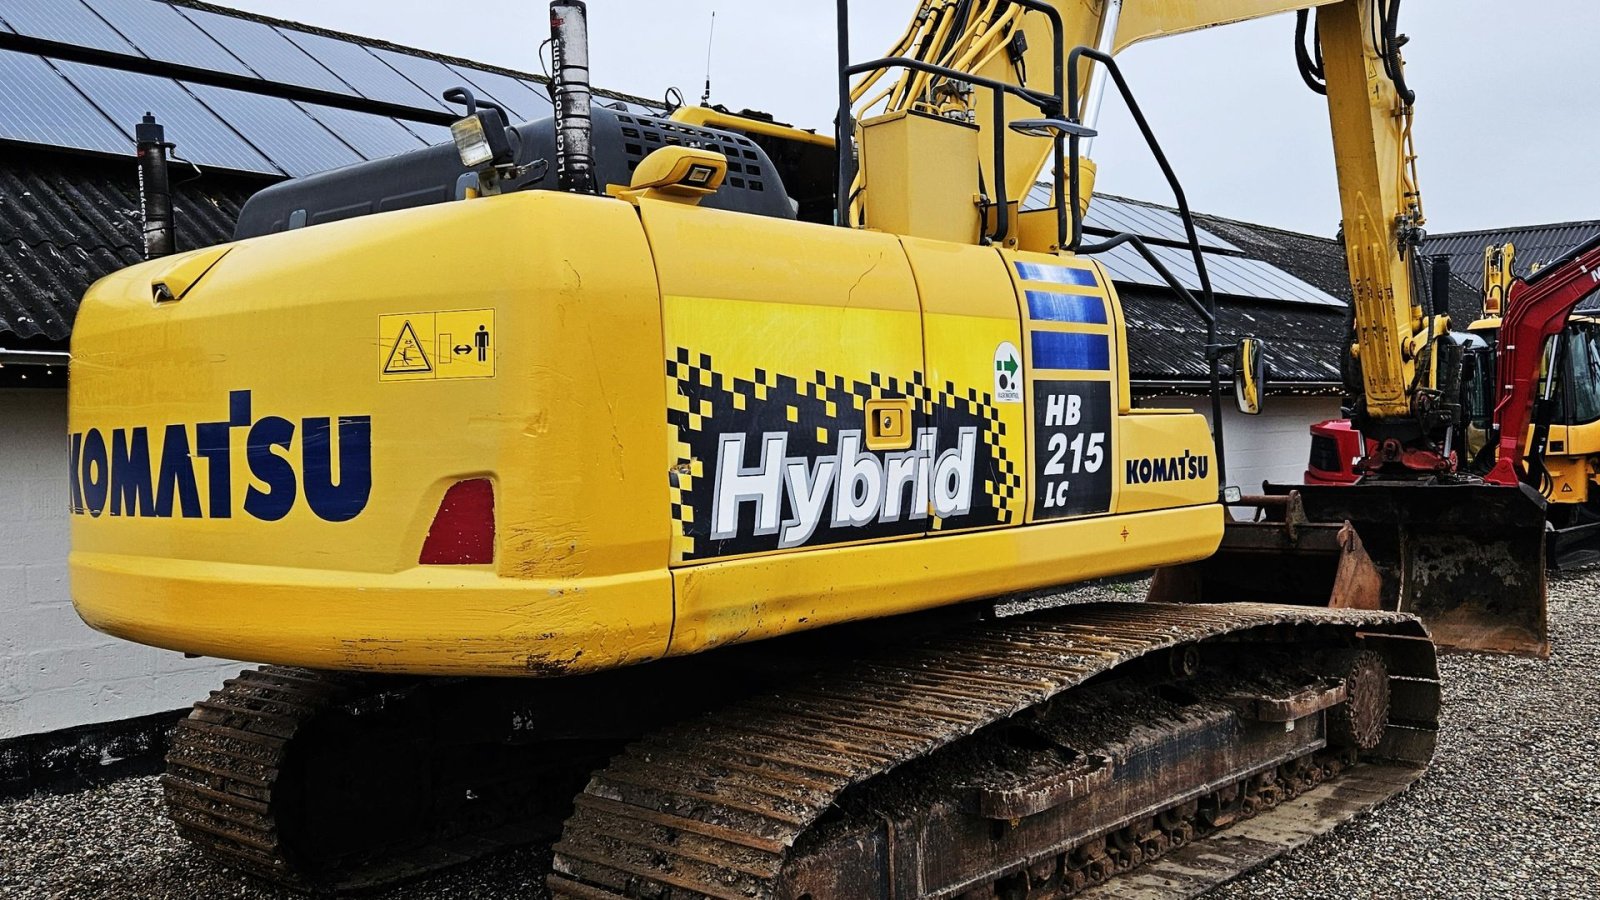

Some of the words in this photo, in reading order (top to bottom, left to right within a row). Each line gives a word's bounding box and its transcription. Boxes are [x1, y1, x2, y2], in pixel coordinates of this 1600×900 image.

[556, 135, 566, 173] Leica
[1045, 394, 1082, 426] HB
[68, 389, 372, 522] KOMATSU
[1043, 432, 1105, 475] 215
[1126, 449, 1208, 484] KOMATSU
[710, 426, 978, 549] Hybrid
[1043, 481, 1069, 508] LC
